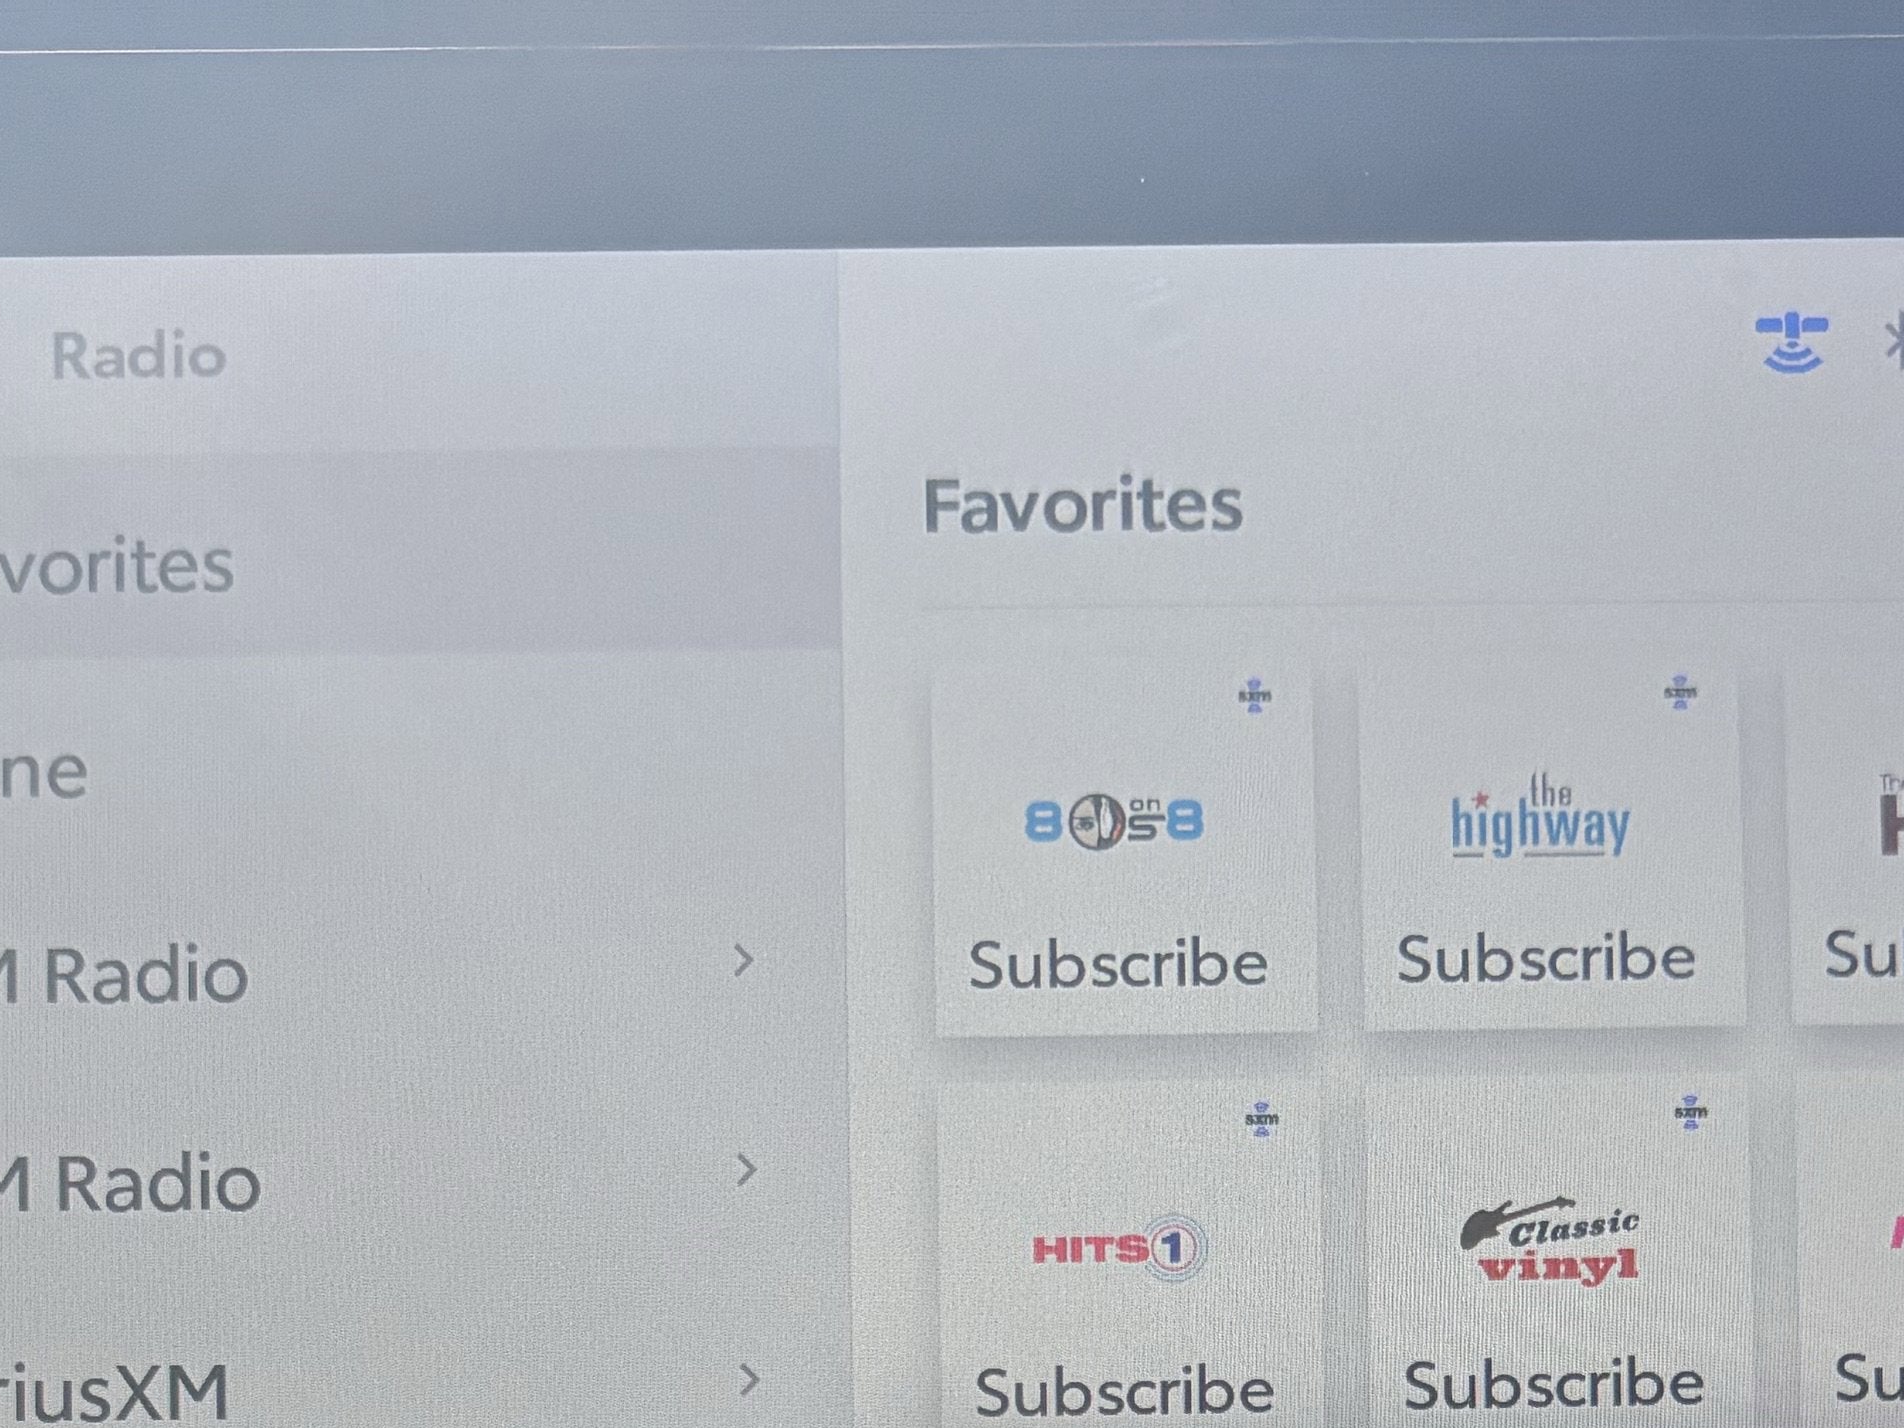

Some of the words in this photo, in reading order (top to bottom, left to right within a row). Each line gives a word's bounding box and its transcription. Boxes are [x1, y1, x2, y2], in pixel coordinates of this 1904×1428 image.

[52, 330, 227, 380] Radio
[923, 472, 1243, 533] Favorites
[1531, 767, 1572, 807] the
[1452, 792, 1630, 858] highway
[46, 943, 248, 1004] Radio
[970, 936, 1267, 989] Subscribe
[1398, 930, 1695, 983] Subscribe
[57, 1151, 261, 1212] Radio
[1509, 1208, 1640, 1247] Classic
[1478, 1248, 1639, 1288] vinyl
[977, 1363, 1274, 1417] Subscribe
[1406, 1355, 1704, 1410] Subscribe
